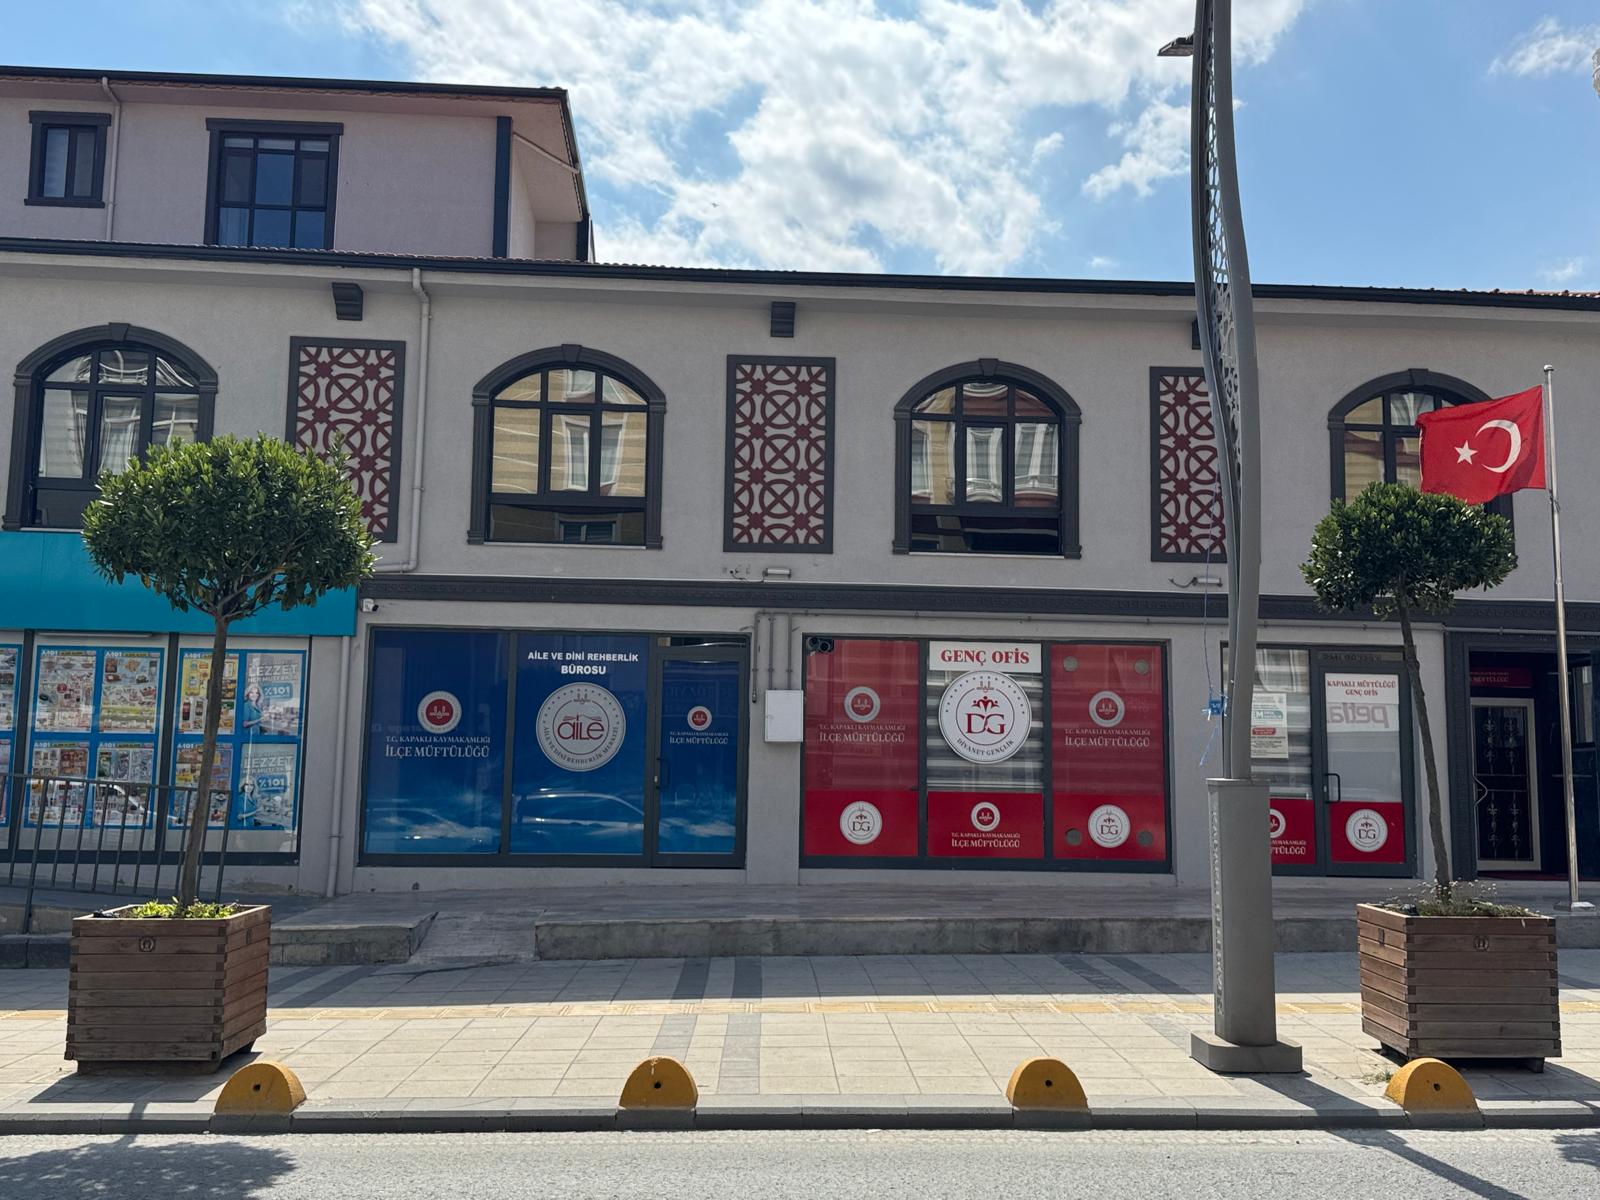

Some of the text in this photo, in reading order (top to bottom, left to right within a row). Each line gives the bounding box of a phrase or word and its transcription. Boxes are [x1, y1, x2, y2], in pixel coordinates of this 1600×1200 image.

[527, 650, 639, 662] AİLE VE DİNİ REHBERLİK
[941, 648, 1030, 666] GENÇ OFİS
[561, 664, 606, 675] BÜROSU
[1327, 680, 1396, 688] KAPAKLI MÜFTÜLÜĞÜ
[264, 687, 290, 696] %101
[965, 713, 1006, 735] DG
[386, 735, 398, 743] T.C.
[820, 732, 905, 743] İLÇE MÜFTÜLÜĞÜ
[1065, 736, 1150, 747] İLÇE MÜFTÜLÜĞÜ
[386, 744, 490, 758] İLÇE MÜFTÜLÜĞÜ
[986, 740, 1015, 756] GENÇLİK
[259, 778, 285, 788] %101
[951, 838, 1020, 848] İLÇE MÜFTÜLÜĞÜ
